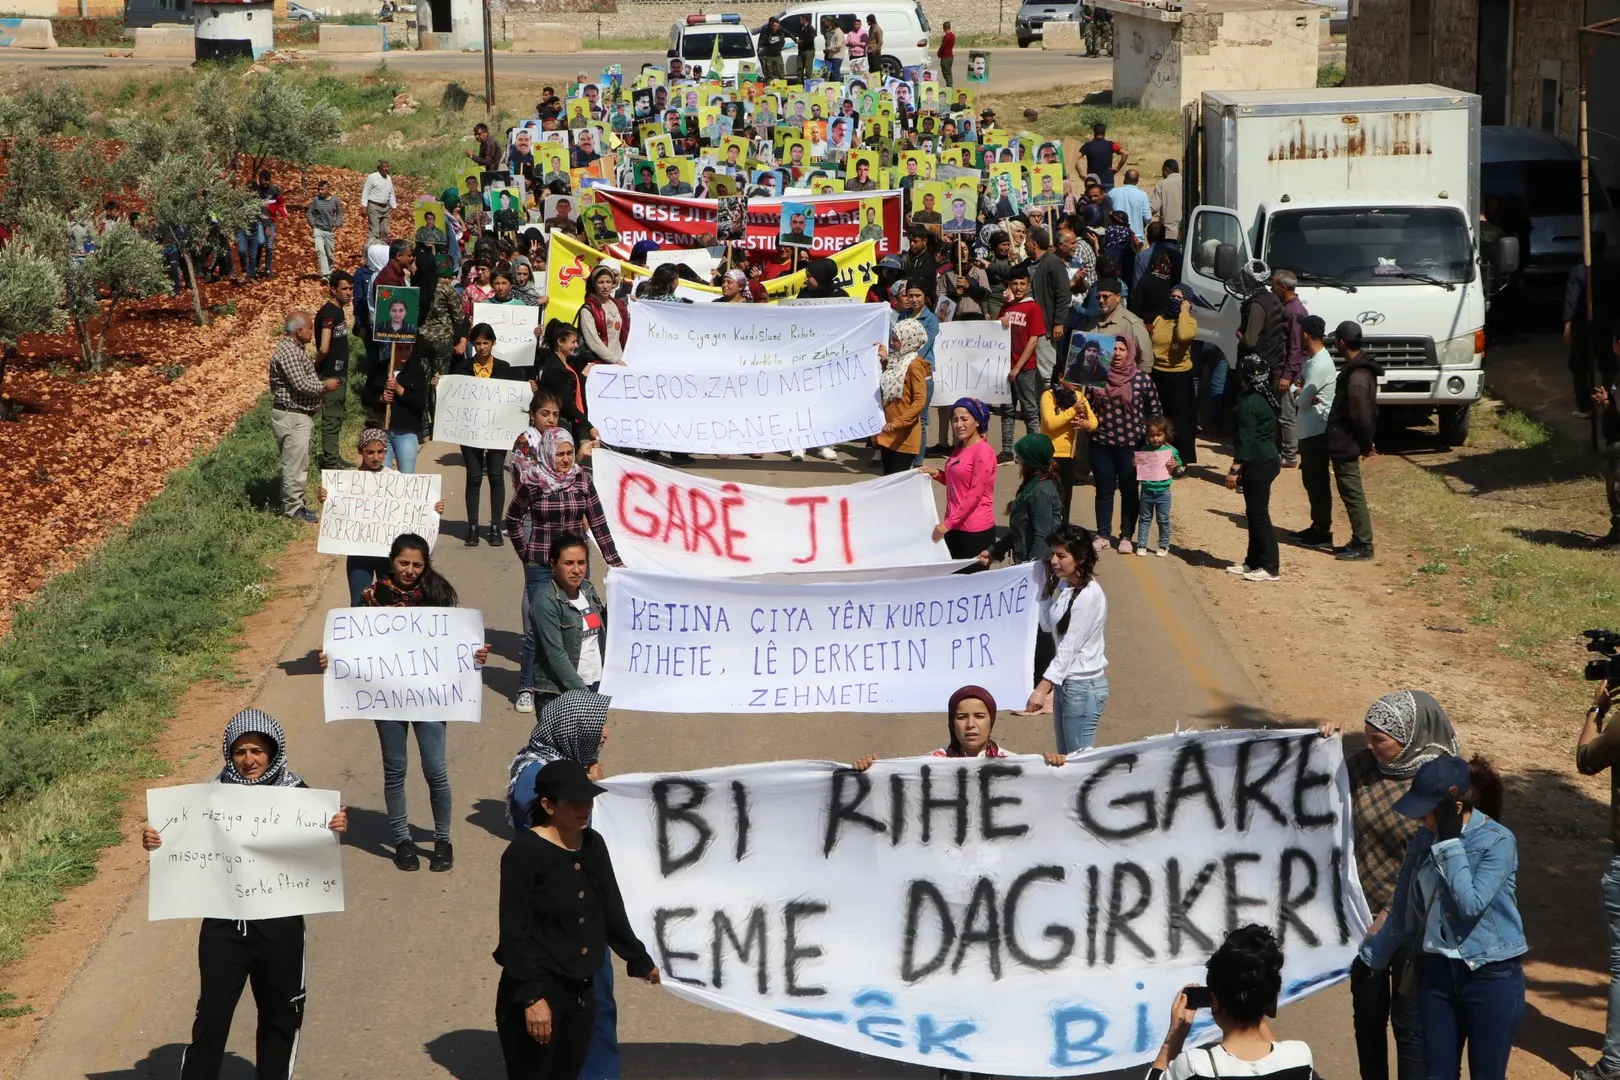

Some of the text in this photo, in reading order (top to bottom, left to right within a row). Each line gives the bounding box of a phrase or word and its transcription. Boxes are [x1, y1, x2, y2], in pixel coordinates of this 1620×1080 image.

[632, 204, 680, 222] BESE
[684, 209, 700, 222] JI
[617, 472, 854, 565] GARÊ JI
[631, 577, 1028, 635] KETINA ÇIYA YÊN KURDISTANÊ
[333, 646, 439, 683] DIJMIN
[753, 639, 778, 675] LÊ
[792, 637, 927, 676] DERKETIN
[950, 632, 995, 670] PIR
[651, 733, 1339, 878] BI RIHE GARE
[654, 899, 830, 997] EME
